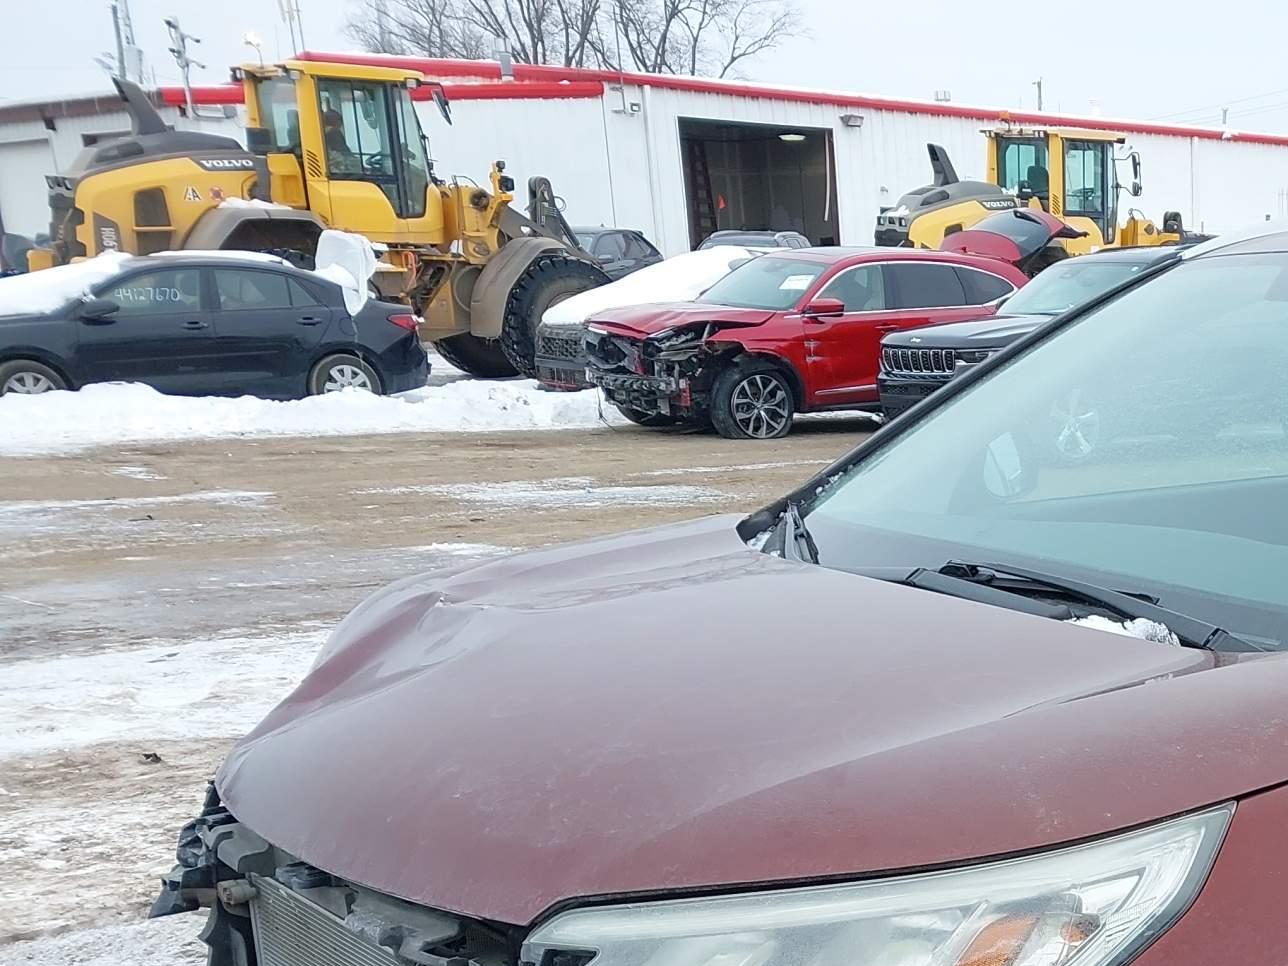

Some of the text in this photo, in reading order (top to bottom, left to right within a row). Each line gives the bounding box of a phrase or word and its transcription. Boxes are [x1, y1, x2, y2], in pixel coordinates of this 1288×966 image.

[200, 159, 254, 168] VOLVO
[982, 200, 1015, 208] VOLVO
[114, 287, 181, 302] 44127670
